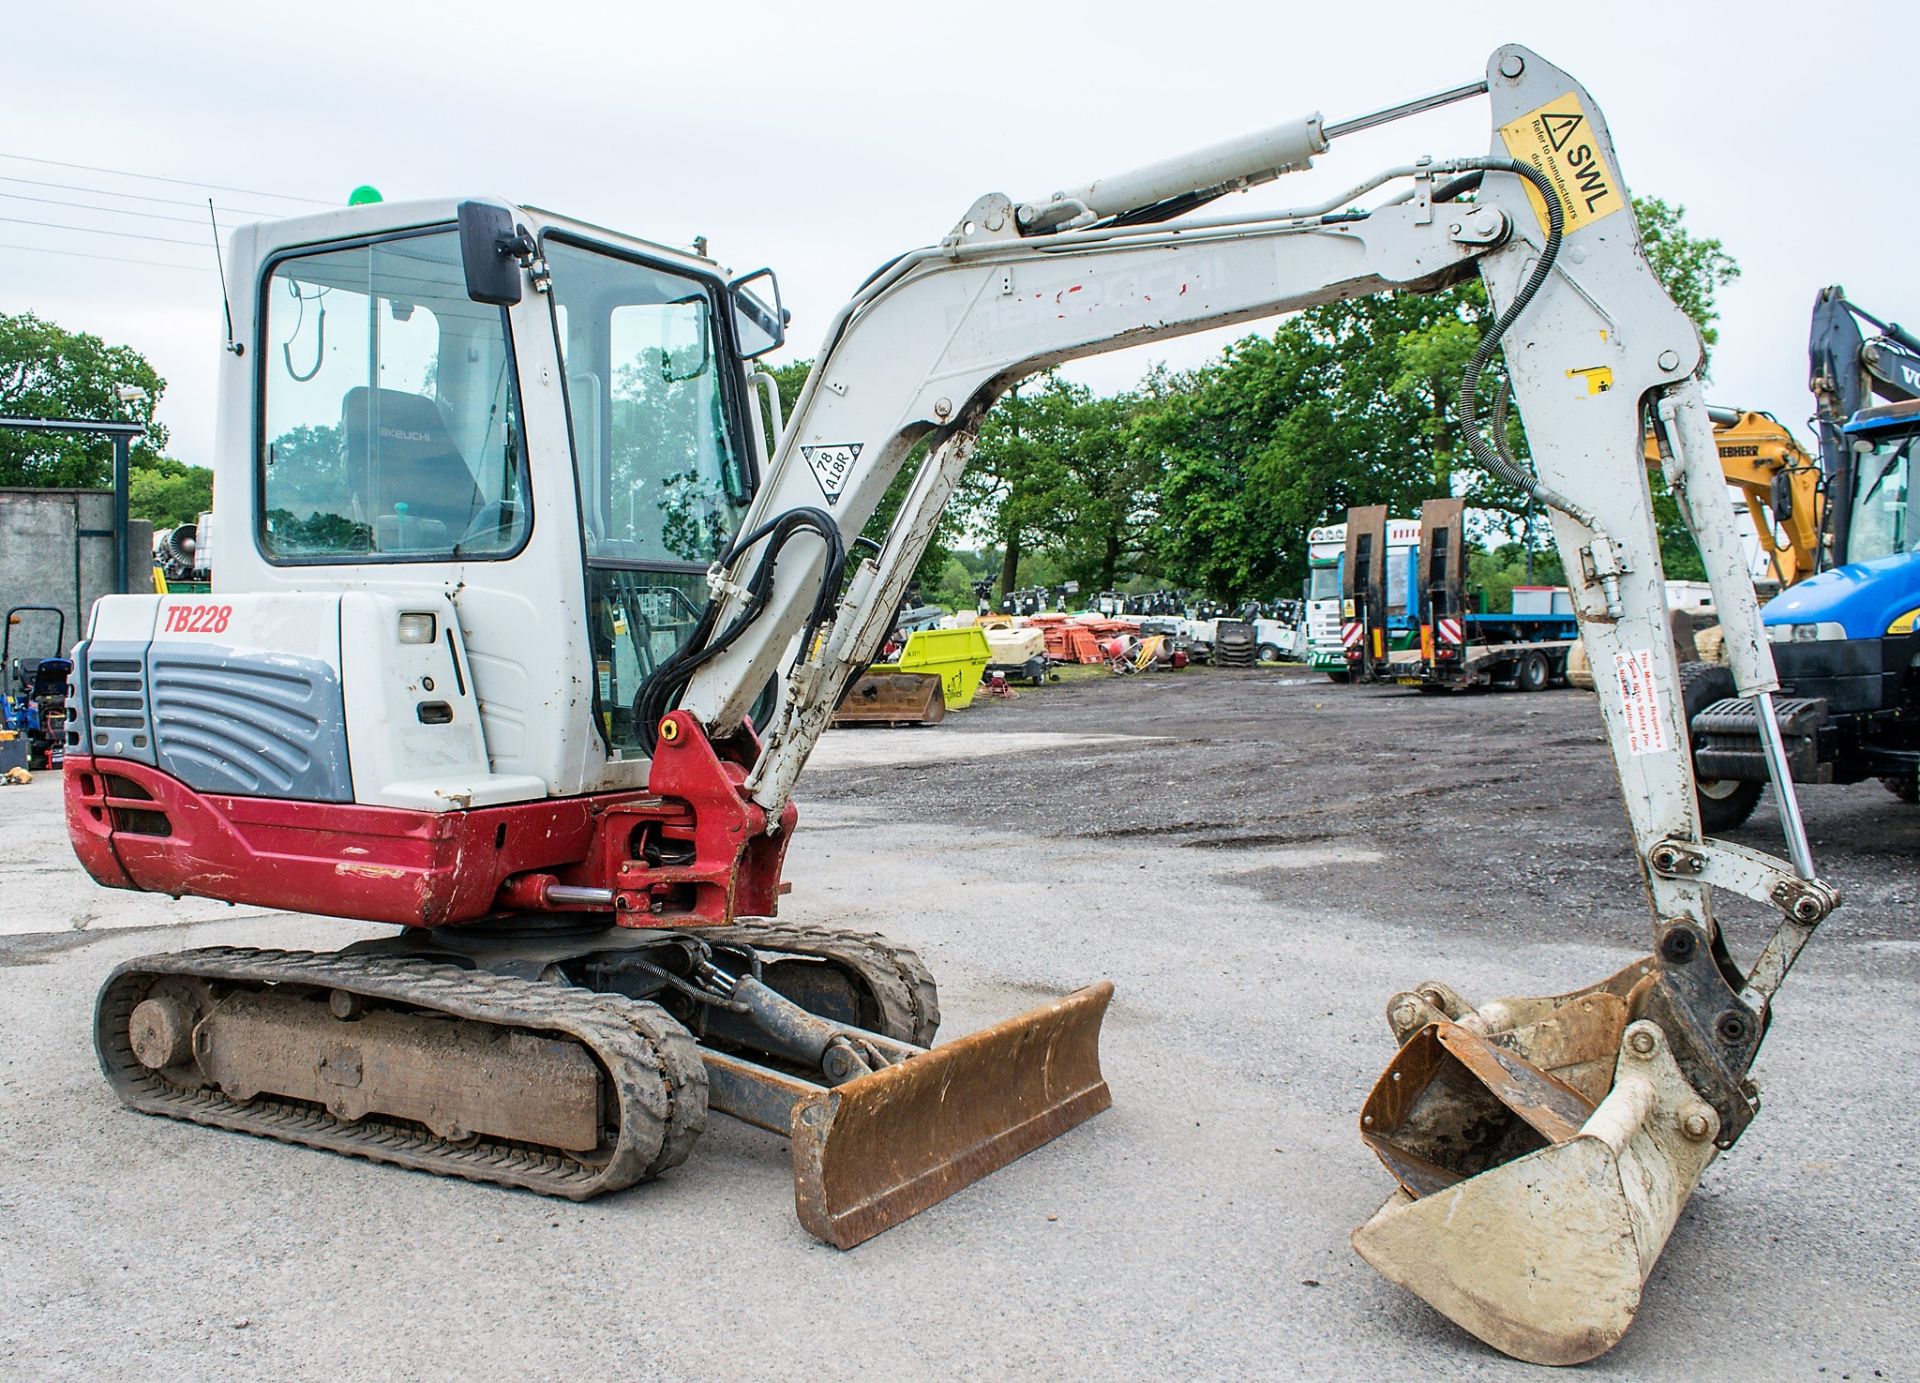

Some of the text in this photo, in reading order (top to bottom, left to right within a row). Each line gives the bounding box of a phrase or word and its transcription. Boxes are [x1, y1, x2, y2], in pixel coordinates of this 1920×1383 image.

[1532, 120, 1545, 144] Refer
[1542, 145, 1550, 155] to
[1547, 156, 1578, 219] manufacturers
[1567, 144, 1608, 213] SWL
[816, 452, 833, 471] 78
[1719, 445, 1759, 457] IEBHERR
[165, 606, 232, 633] TB228
[1638, 705, 1647, 730] Safety
[1644, 671, 1654, 703] Machine
[1650, 706, 1660, 740] Requires
